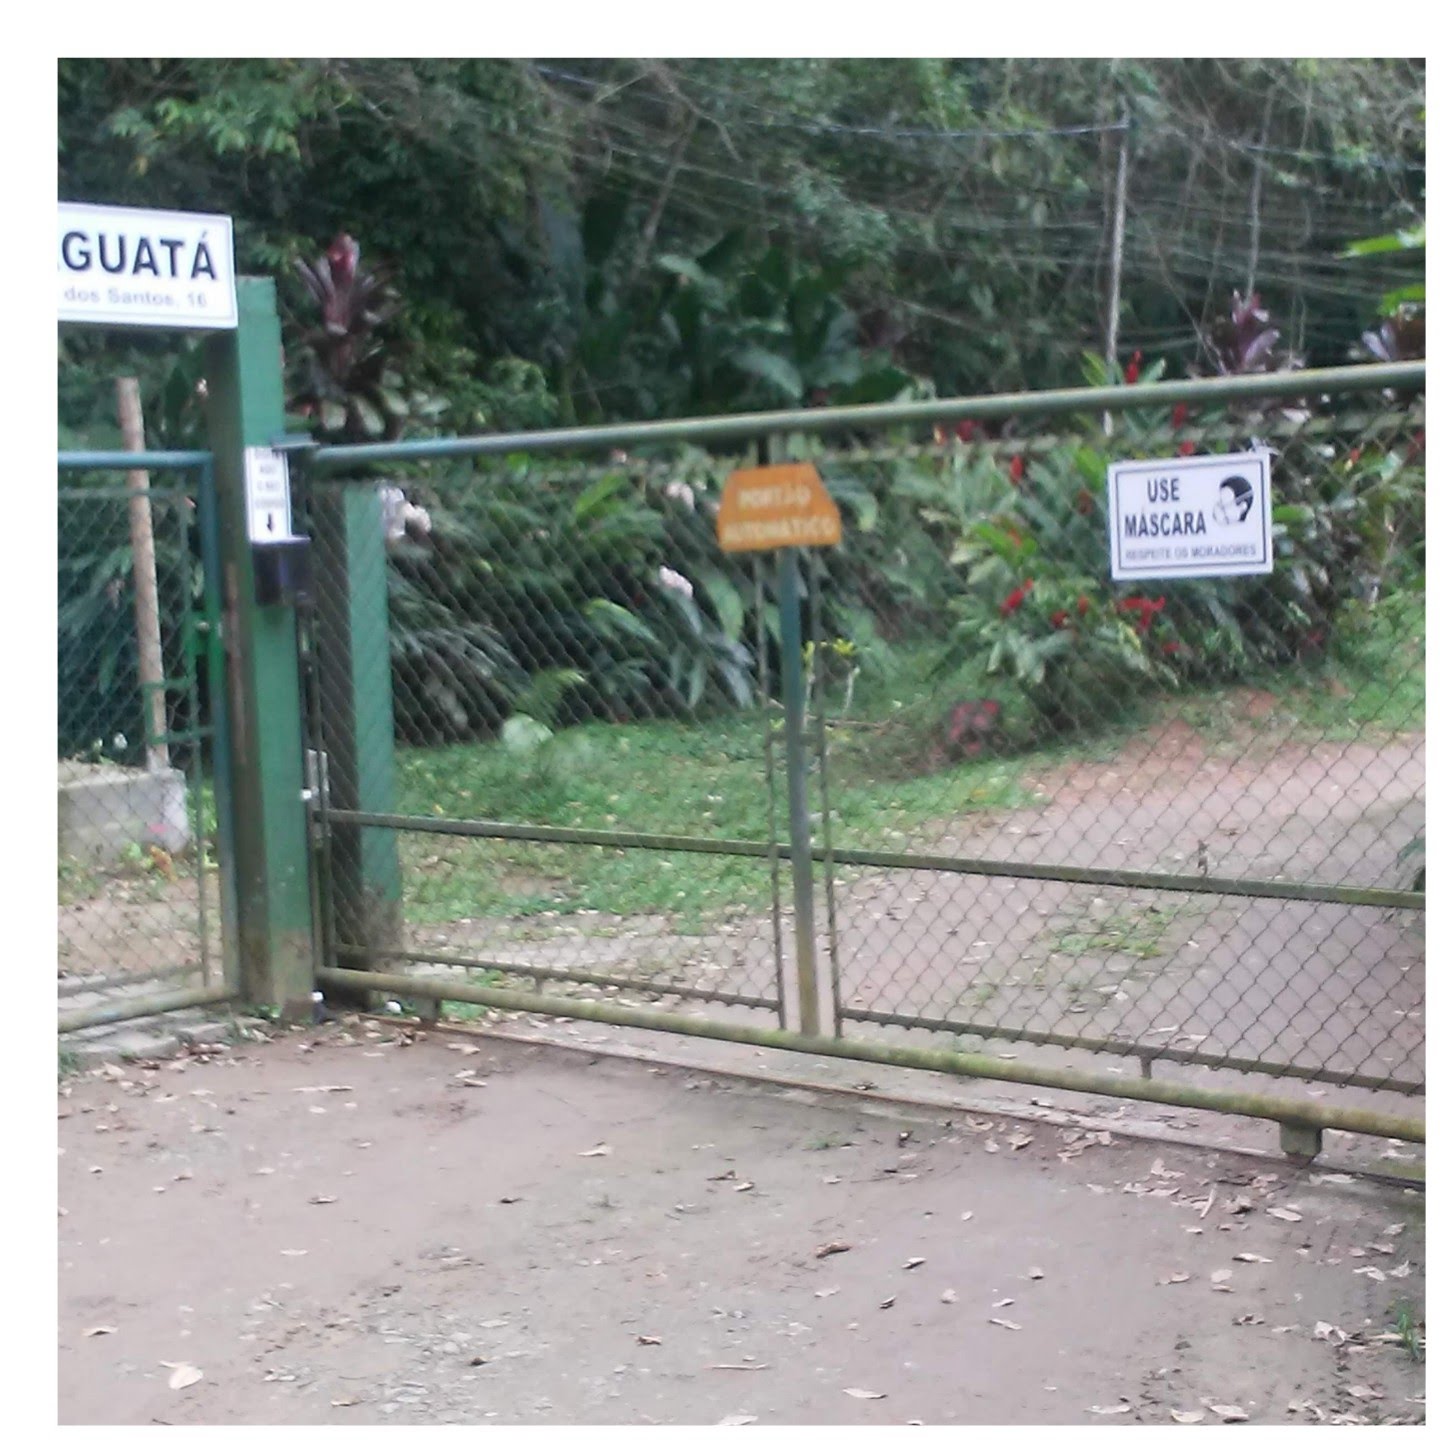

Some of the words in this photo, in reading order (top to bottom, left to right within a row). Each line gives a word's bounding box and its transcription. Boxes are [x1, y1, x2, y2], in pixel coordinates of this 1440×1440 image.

[58, 231, 218, 281] GUATÁ
[64, 286, 101, 302] dos
[1146, 478, 1180, 502] USE
[1124, 507, 1208, 537] MÁSCARA
[1191, 543, 1257, 559] MORADORES
